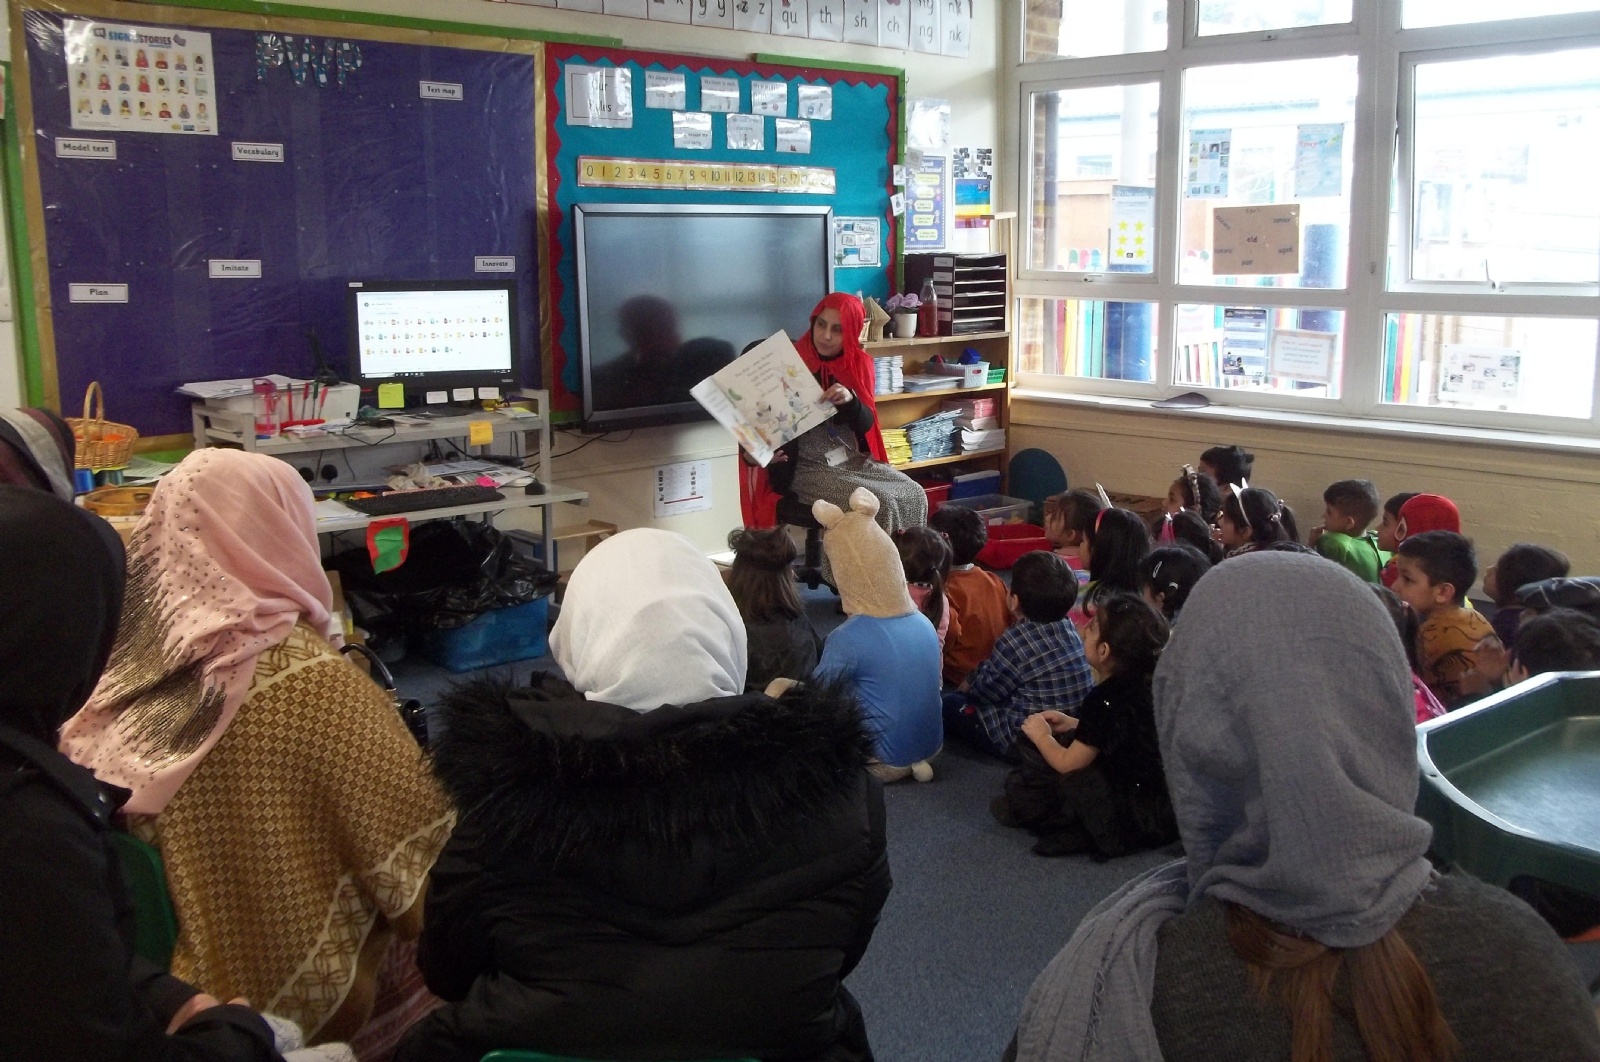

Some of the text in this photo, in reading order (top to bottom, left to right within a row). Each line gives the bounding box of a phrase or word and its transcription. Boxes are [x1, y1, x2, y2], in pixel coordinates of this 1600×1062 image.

[717, 0, 726, 17] y
[758, 2, 765, 15] z
[819, 5, 833, 24] th
[782, 10, 798, 30] qu
[854, 10, 868, 29] sh
[886, 16, 900, 34] ch
[138, 34, 172, 46] STORIES
[918, 25, 933, 43] ng
[948, 25, 962, 42] nk
[427, 85, 456, 96] Text map
[63, 142, 90, 151] Model
[237, 146, 279, 158] Vocabulary
[586, 165, 594, 177] 0
[615, 166, 621, 178] 2
[627, 167, 634, 179] 3
[640, 167, 647, 179] 4
[653, 168, 660, 180] 5
[666, 167, 672, 180] 6
[677, 169, 684, 179] 7
[689, 169, 695, 181] 8
[700, 170, 707, 181] 9
[711, 170, 721, 182] 10
[724, 170, 730, 182] 11
[735, 171, 744, 183] 12
[747, 171, 756, 183] 13
[758, 171, 766, 183] 14
[768, 171, 777, 183] 15
[779, 172, 788, 184] 16
[1278, 247, 1293, 256] aged
[221, 263, 250, 272] Imitate
[482, 259, 509, 268] Innovate
[89, 287, 109, 297] Plan
